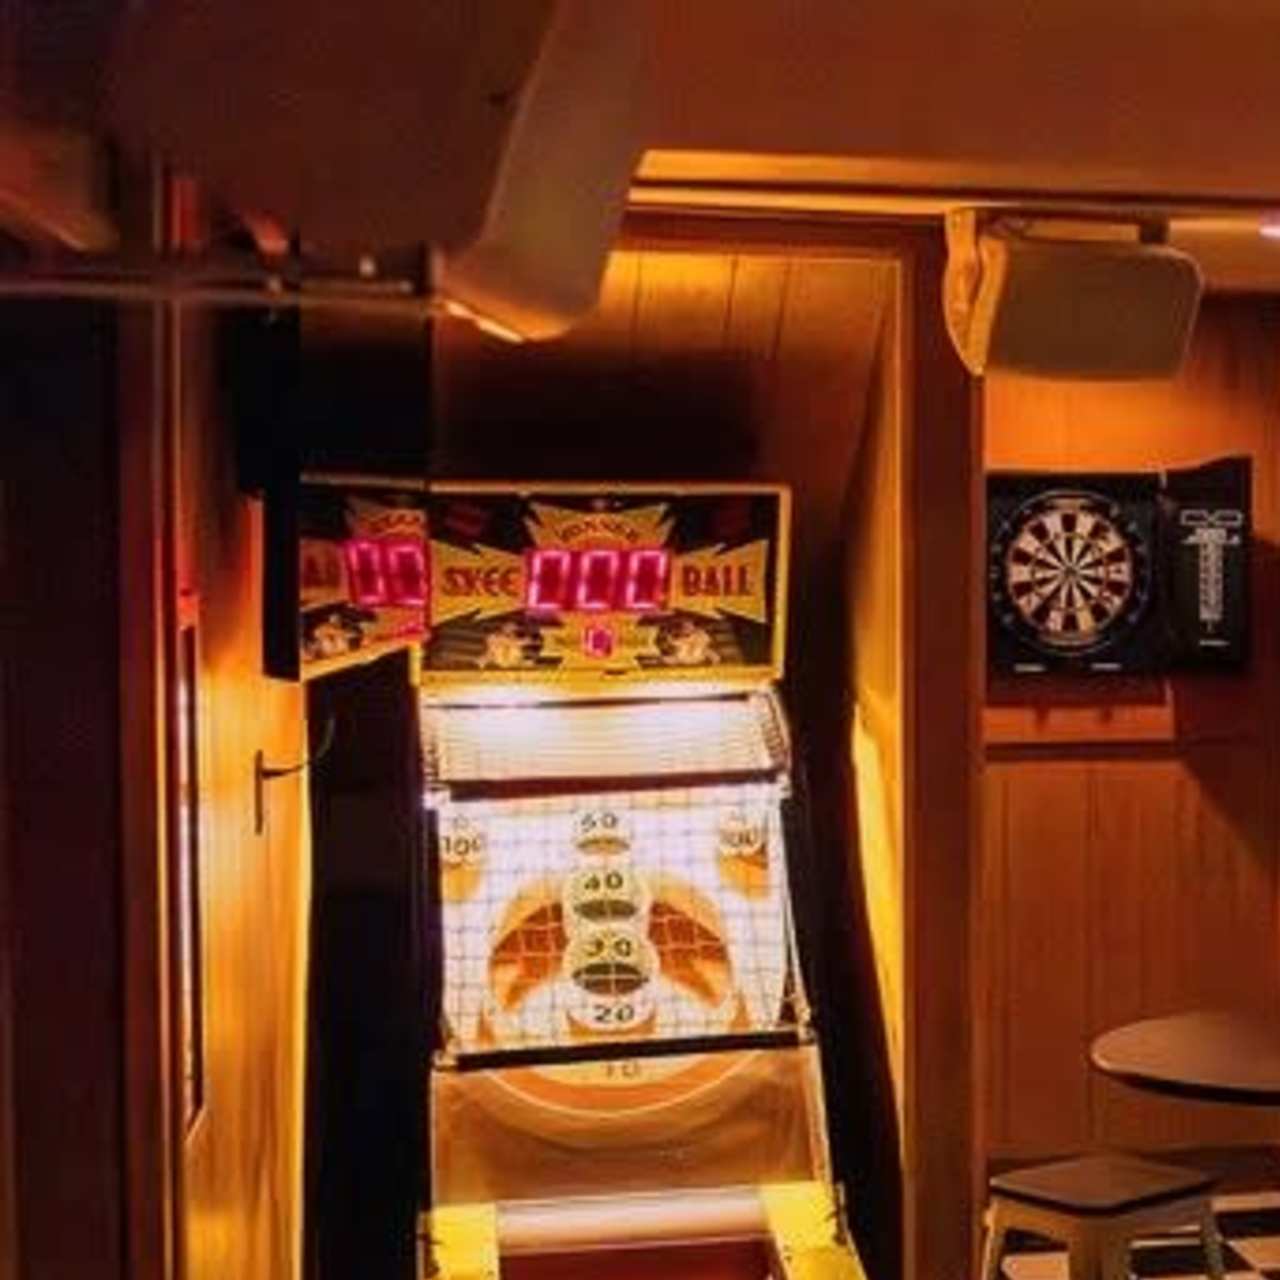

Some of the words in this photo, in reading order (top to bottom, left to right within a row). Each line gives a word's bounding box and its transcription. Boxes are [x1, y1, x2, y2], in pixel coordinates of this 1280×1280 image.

[527, 550, 669, 609] 000
[681, 563, 751, 597] BALL
[582, 870, 624, 891] 40
[593, 1003, 635, 1023] 20
